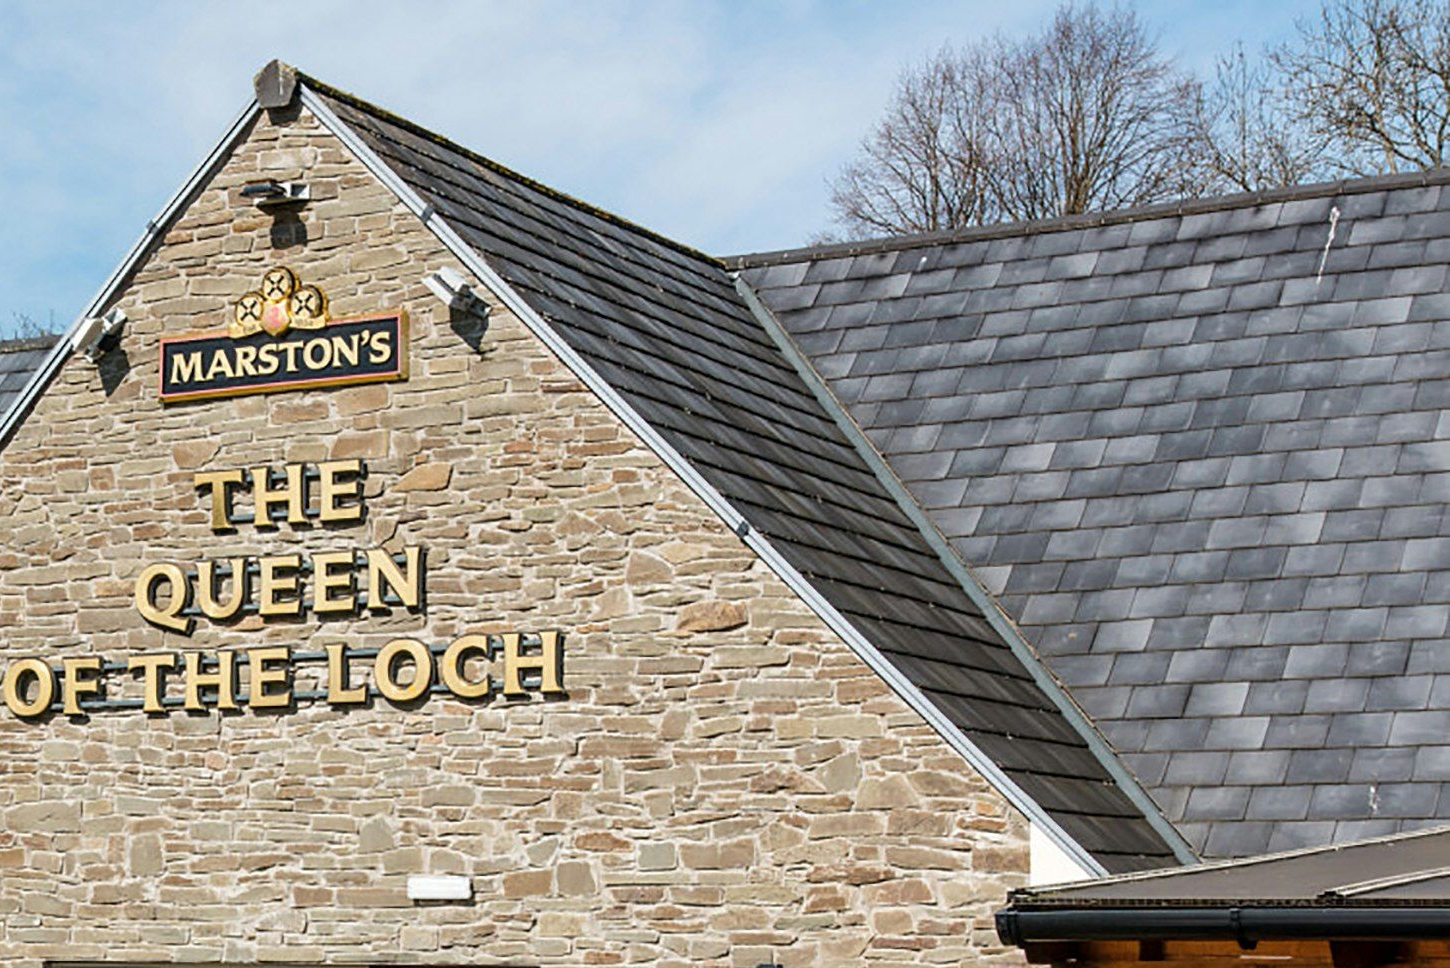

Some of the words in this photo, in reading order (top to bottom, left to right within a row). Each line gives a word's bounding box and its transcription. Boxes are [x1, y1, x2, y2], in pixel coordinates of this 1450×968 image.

[170, 330, 392, 384] MARSTON'S
[194, 460, 365, 531] THE
[134, 546, 424, 633] QUEEN
[3, 657, 102, 717] OF
[128, 647, 292, 714] THE
[326, 631, 563, 704] LOCH
